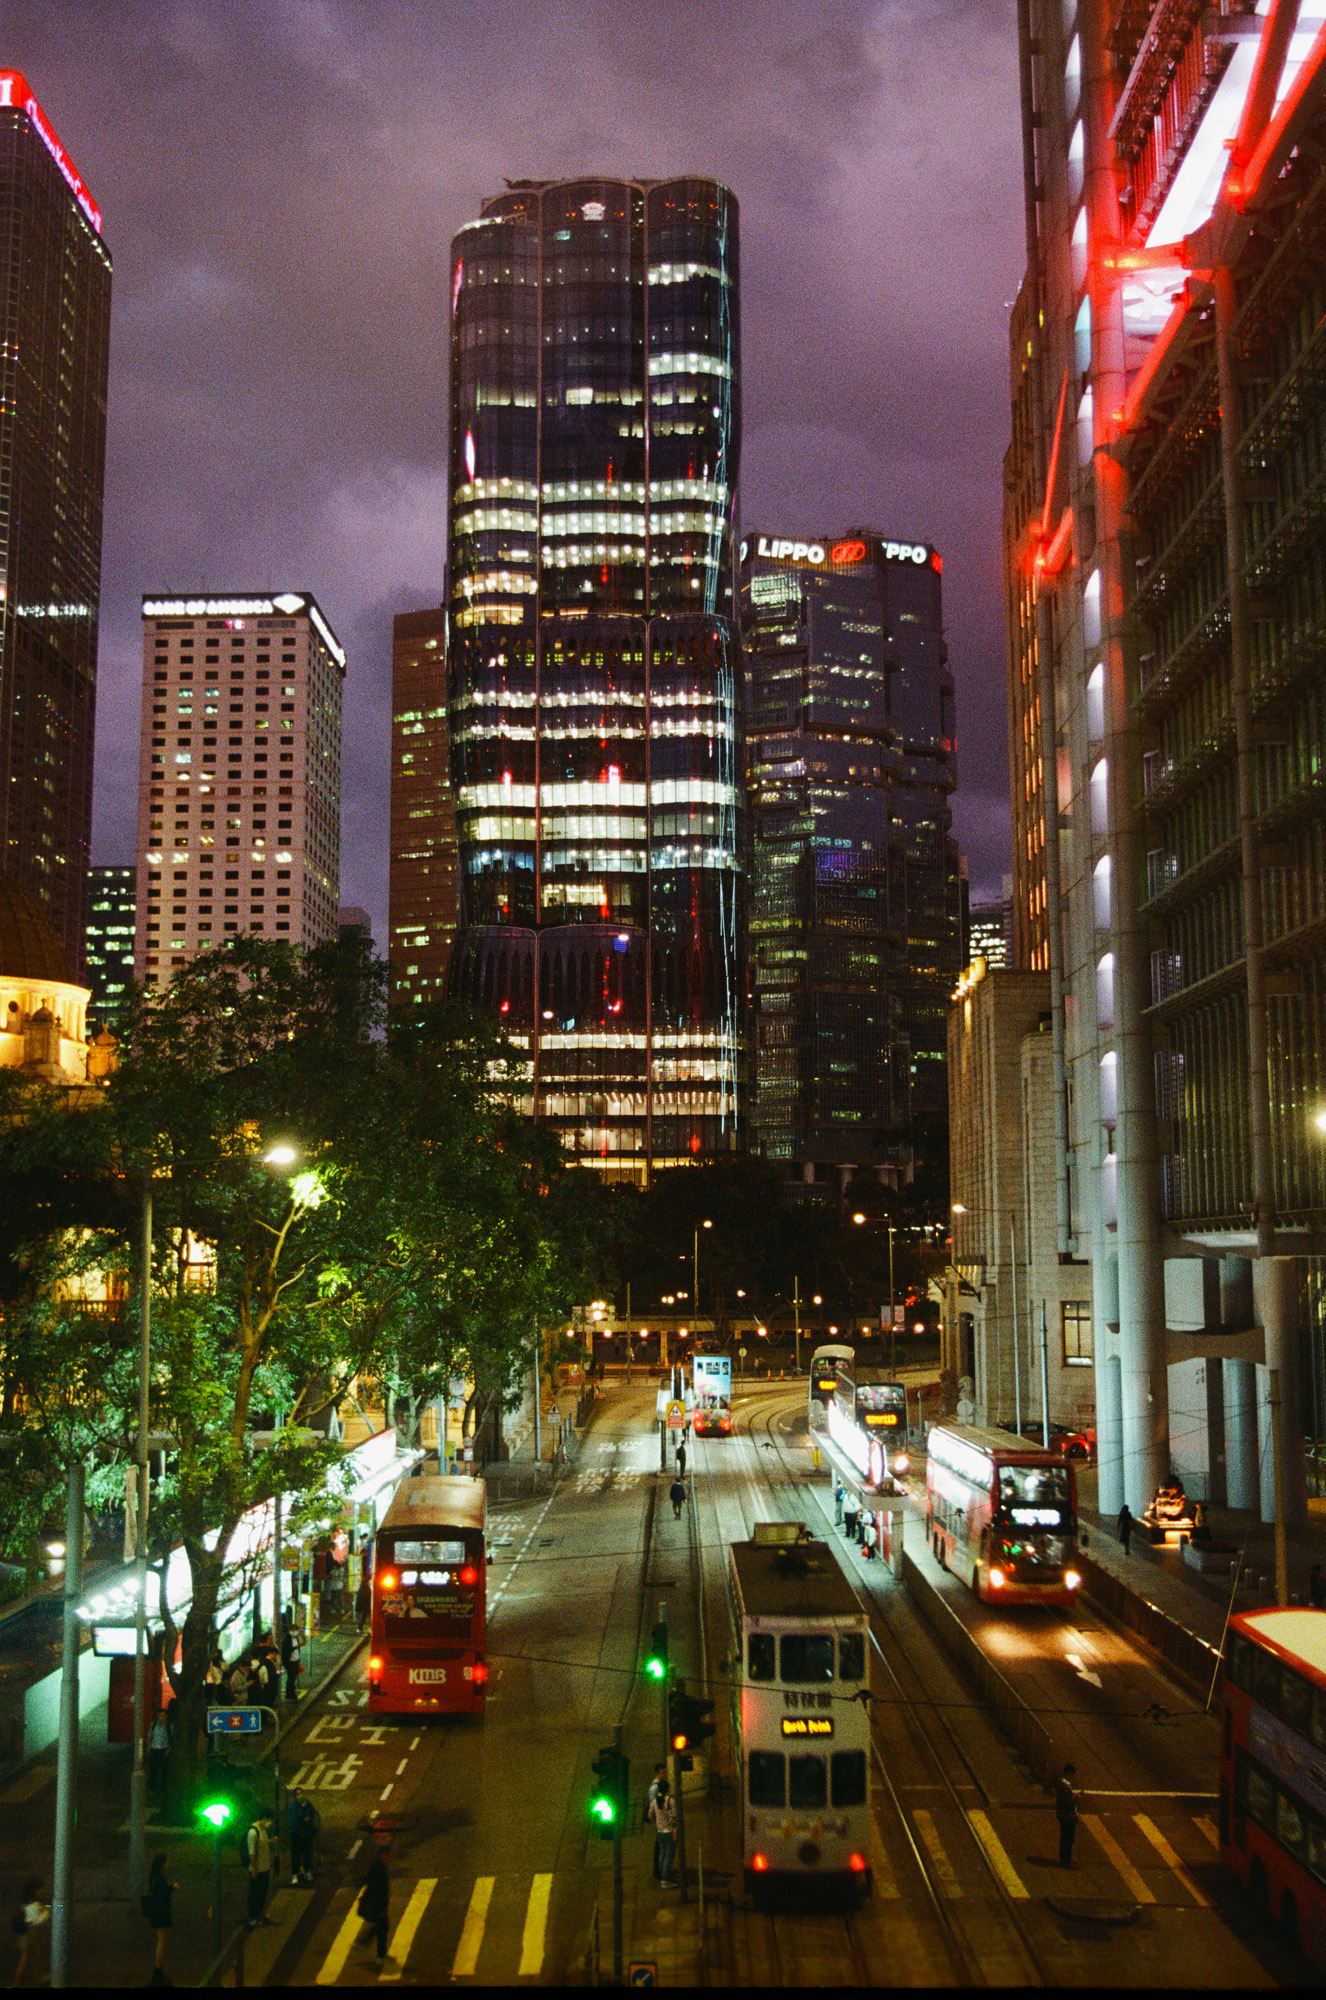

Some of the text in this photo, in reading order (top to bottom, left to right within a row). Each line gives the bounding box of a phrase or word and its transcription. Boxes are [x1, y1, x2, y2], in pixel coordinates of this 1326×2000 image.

[757, 538, 824, 564] LIPPO
[882, 542, 926, 563] PPO
[142, 600, 273, 615] BANK OF AMERICA
[408, 1668, 447, 1684] KMB
[285, 1752, 363, 1790] 站
